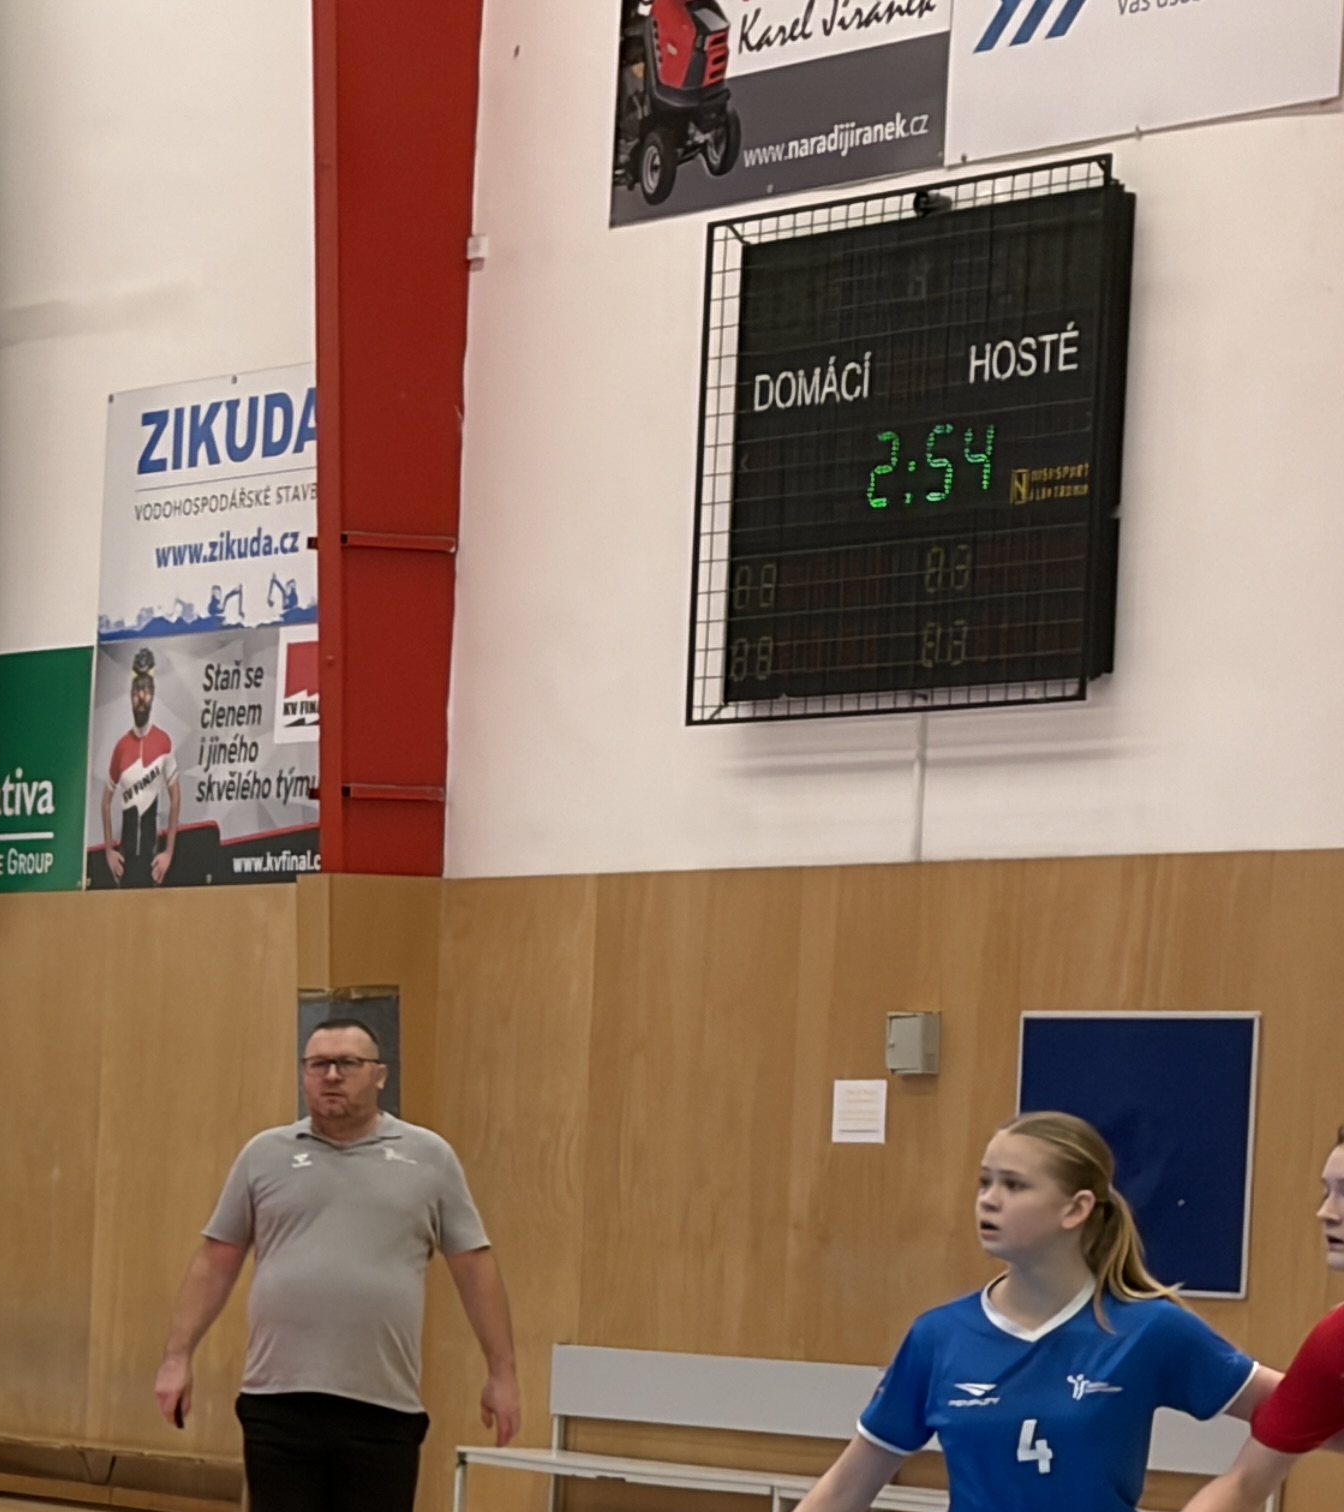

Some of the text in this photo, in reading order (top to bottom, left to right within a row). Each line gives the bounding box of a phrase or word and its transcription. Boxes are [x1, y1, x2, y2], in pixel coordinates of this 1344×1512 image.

[743, 112, 929, 168] www.naradijiranek.cz
[968, 321, 1080, 384] HOSTÉ
[754, 351, 872, 412] DOMÁCÍ
[137, 387, 317, 475] ZIKUDA
[867, 423, 996, 508] 2:54
[155, 527, 300, 568] www.zikuda.cz
[202, 659, 265, 692] Staň se
[200, 699, 263, 729] členem
[203, 733, 259, 773] jiného
[196, 770, 272, 803] skvělého
[1017, 1418, 1053, 1474] 4
